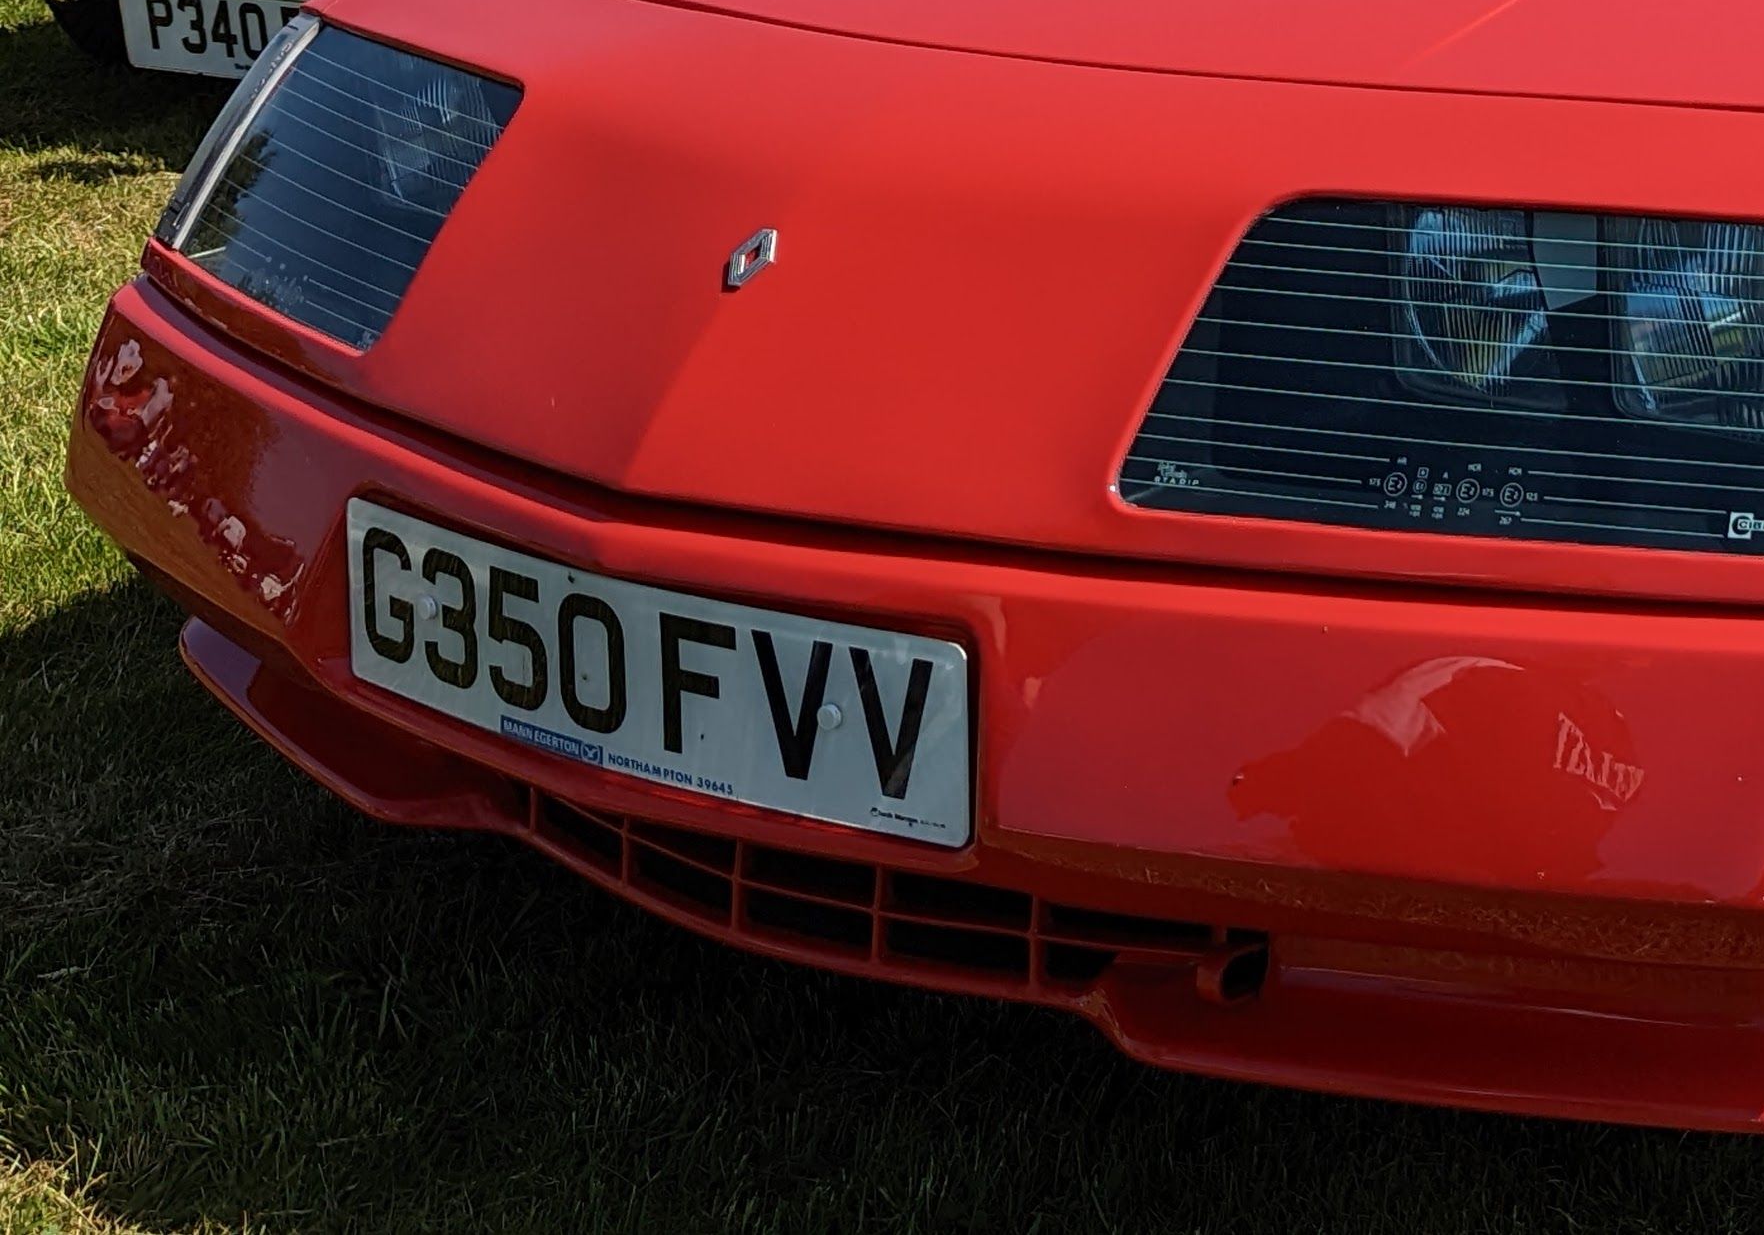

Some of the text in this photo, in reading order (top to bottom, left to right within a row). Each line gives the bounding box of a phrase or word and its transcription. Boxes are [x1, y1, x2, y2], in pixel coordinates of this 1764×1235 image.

[362, 526, 935, 801] G350 FVV
[503, 719, 735, 796] MANN EGERTON NORTHAMPTON 39645
